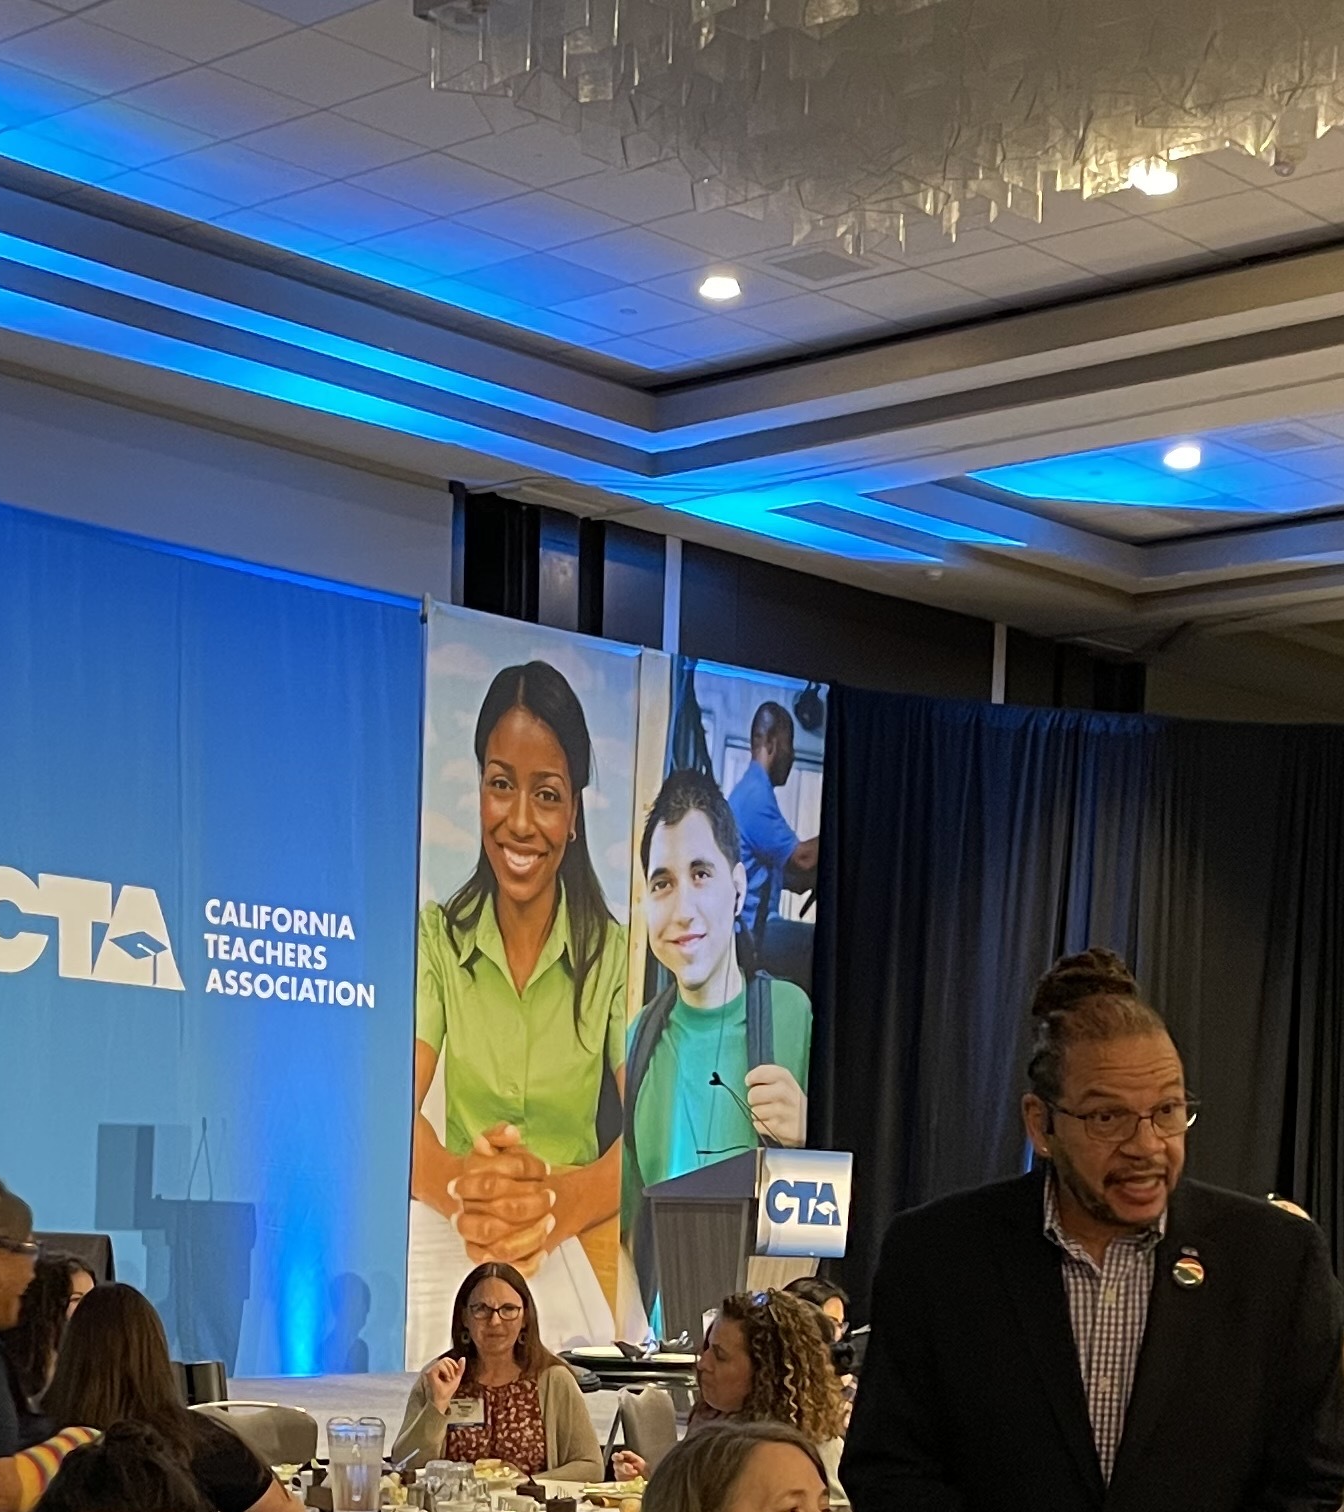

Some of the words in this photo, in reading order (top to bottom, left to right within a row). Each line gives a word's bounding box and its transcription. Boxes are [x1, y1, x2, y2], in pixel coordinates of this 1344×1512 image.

[205, 898, 356, 941] CALIFORNIA
[203, 933, 328, 971] TEACHERS
[205, 968, 375, 1009] ASSOCIATION
[766, 1179, 841, 1226] CTA
